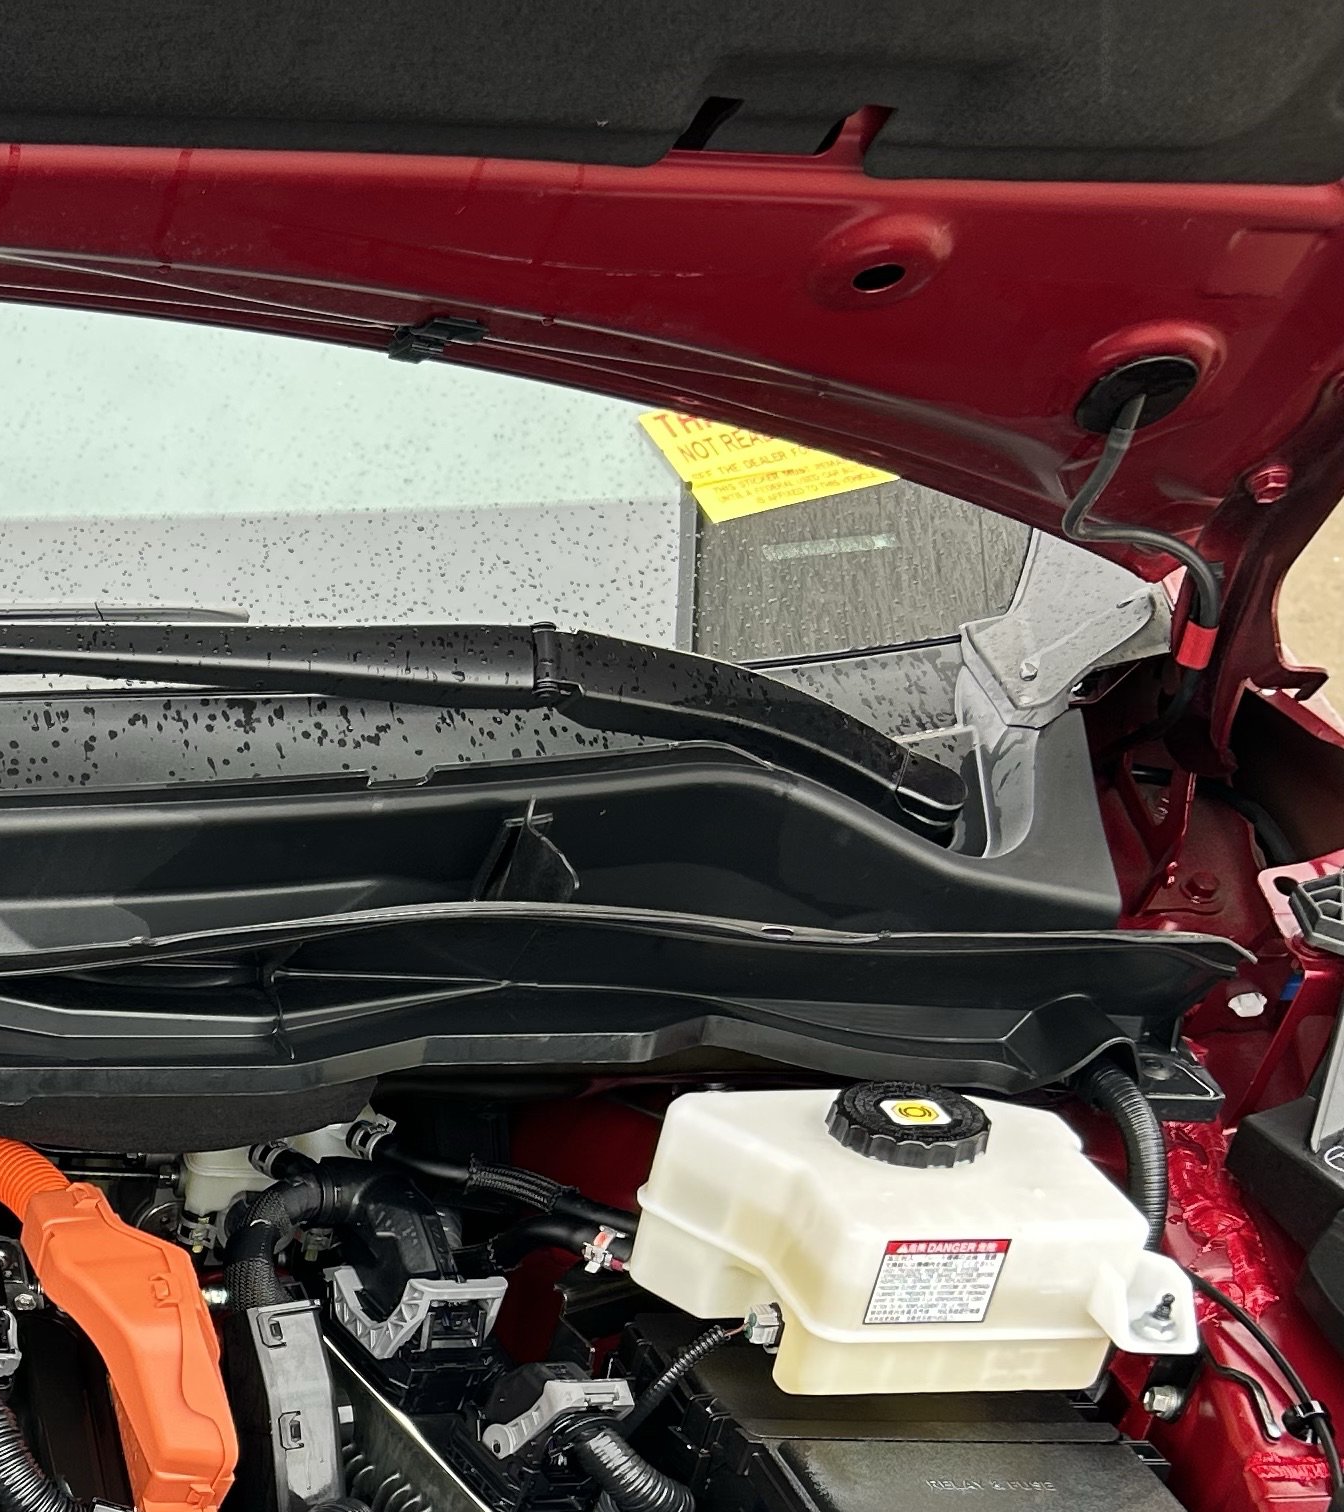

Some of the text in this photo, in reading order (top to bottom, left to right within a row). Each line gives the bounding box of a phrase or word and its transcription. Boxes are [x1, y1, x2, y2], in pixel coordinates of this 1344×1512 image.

[653, 413, 713, 438] TH
[677, 429, 774, 463] NOT REA
[717, 463, 738, 475] THE
[744, 451, 786, 469] DEALER
[926, 1242, 977, 1253] DANGER
[926, 1479, 983, 1491] RELAY
[1007, 1480, 1056, 1492] FUSE
